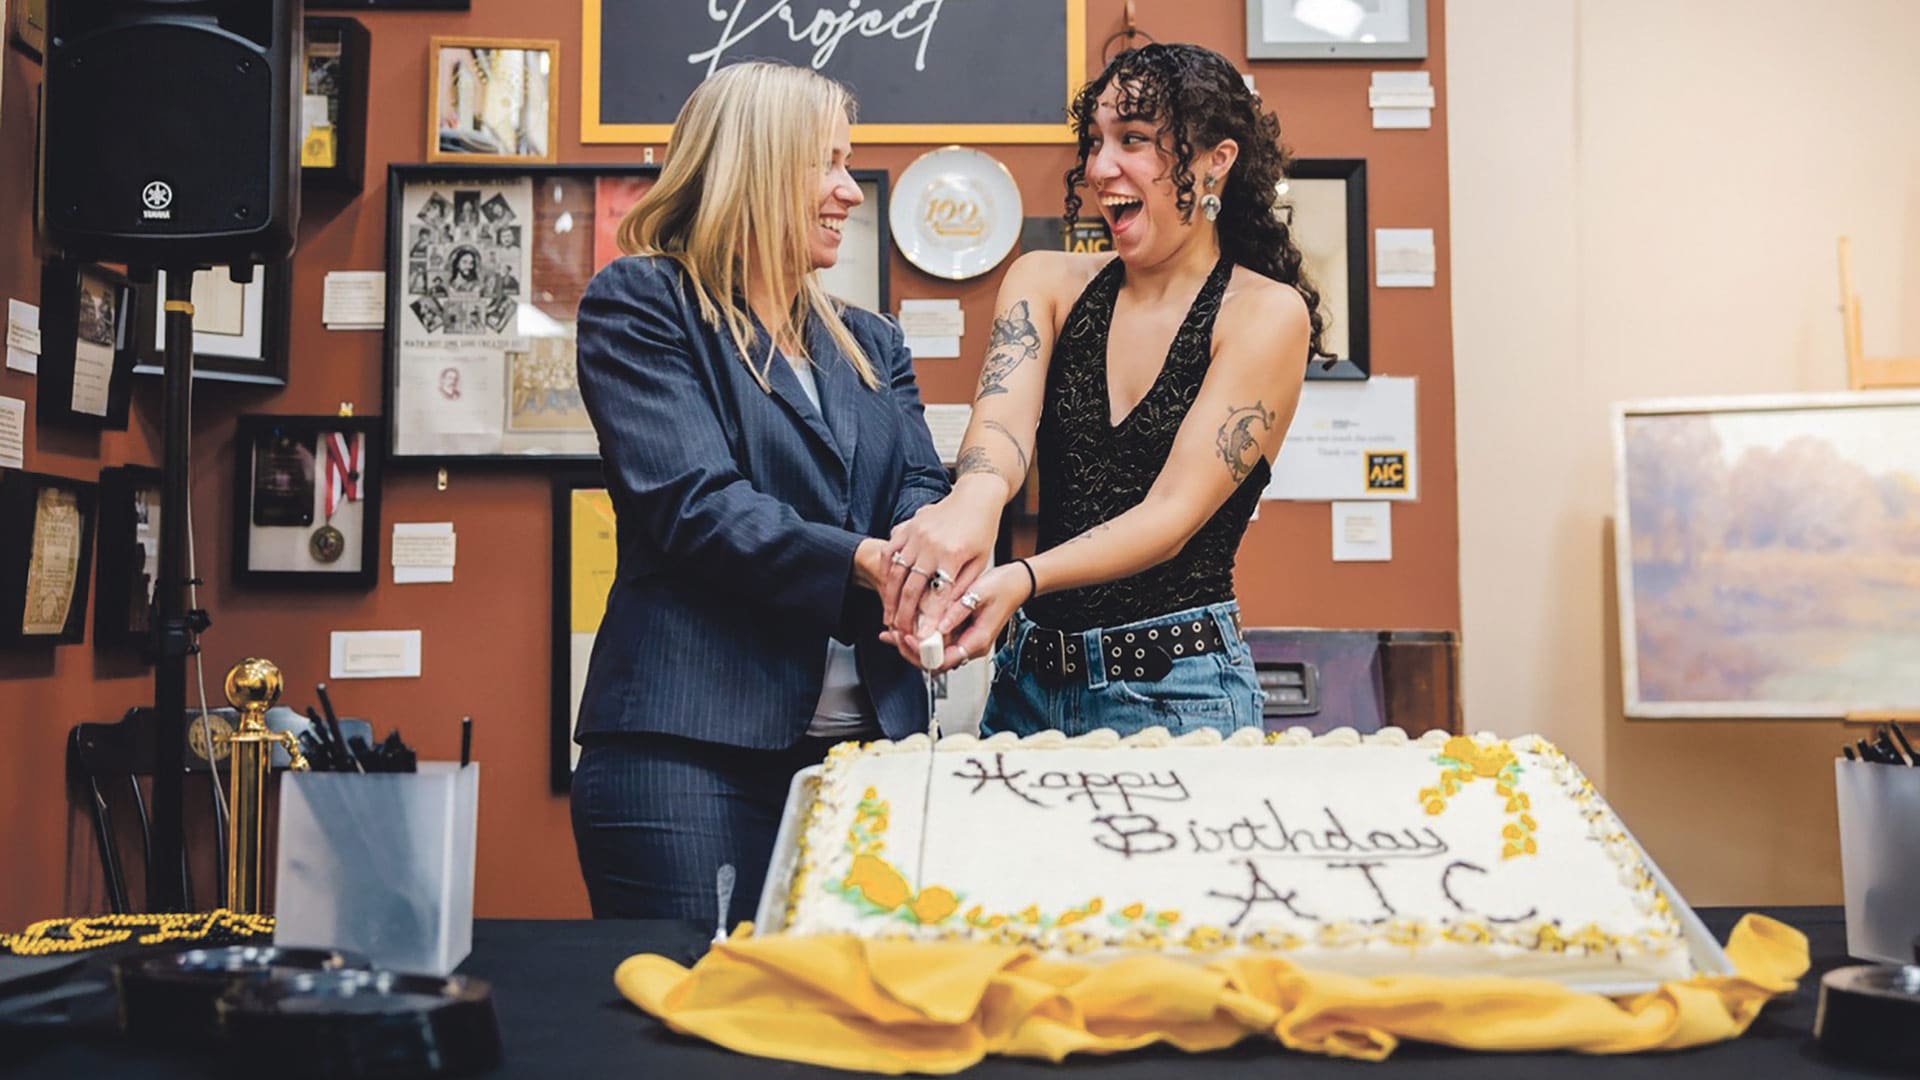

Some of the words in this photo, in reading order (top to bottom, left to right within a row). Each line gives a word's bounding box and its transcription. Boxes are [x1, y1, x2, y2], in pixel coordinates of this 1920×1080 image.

[1073, 238, 1109, 254] AIC
[1370, 463, 1403, 481] AIC
[952, 752, 1190, 812] Happy
[1091, 799, 1448, 859] Birthday
